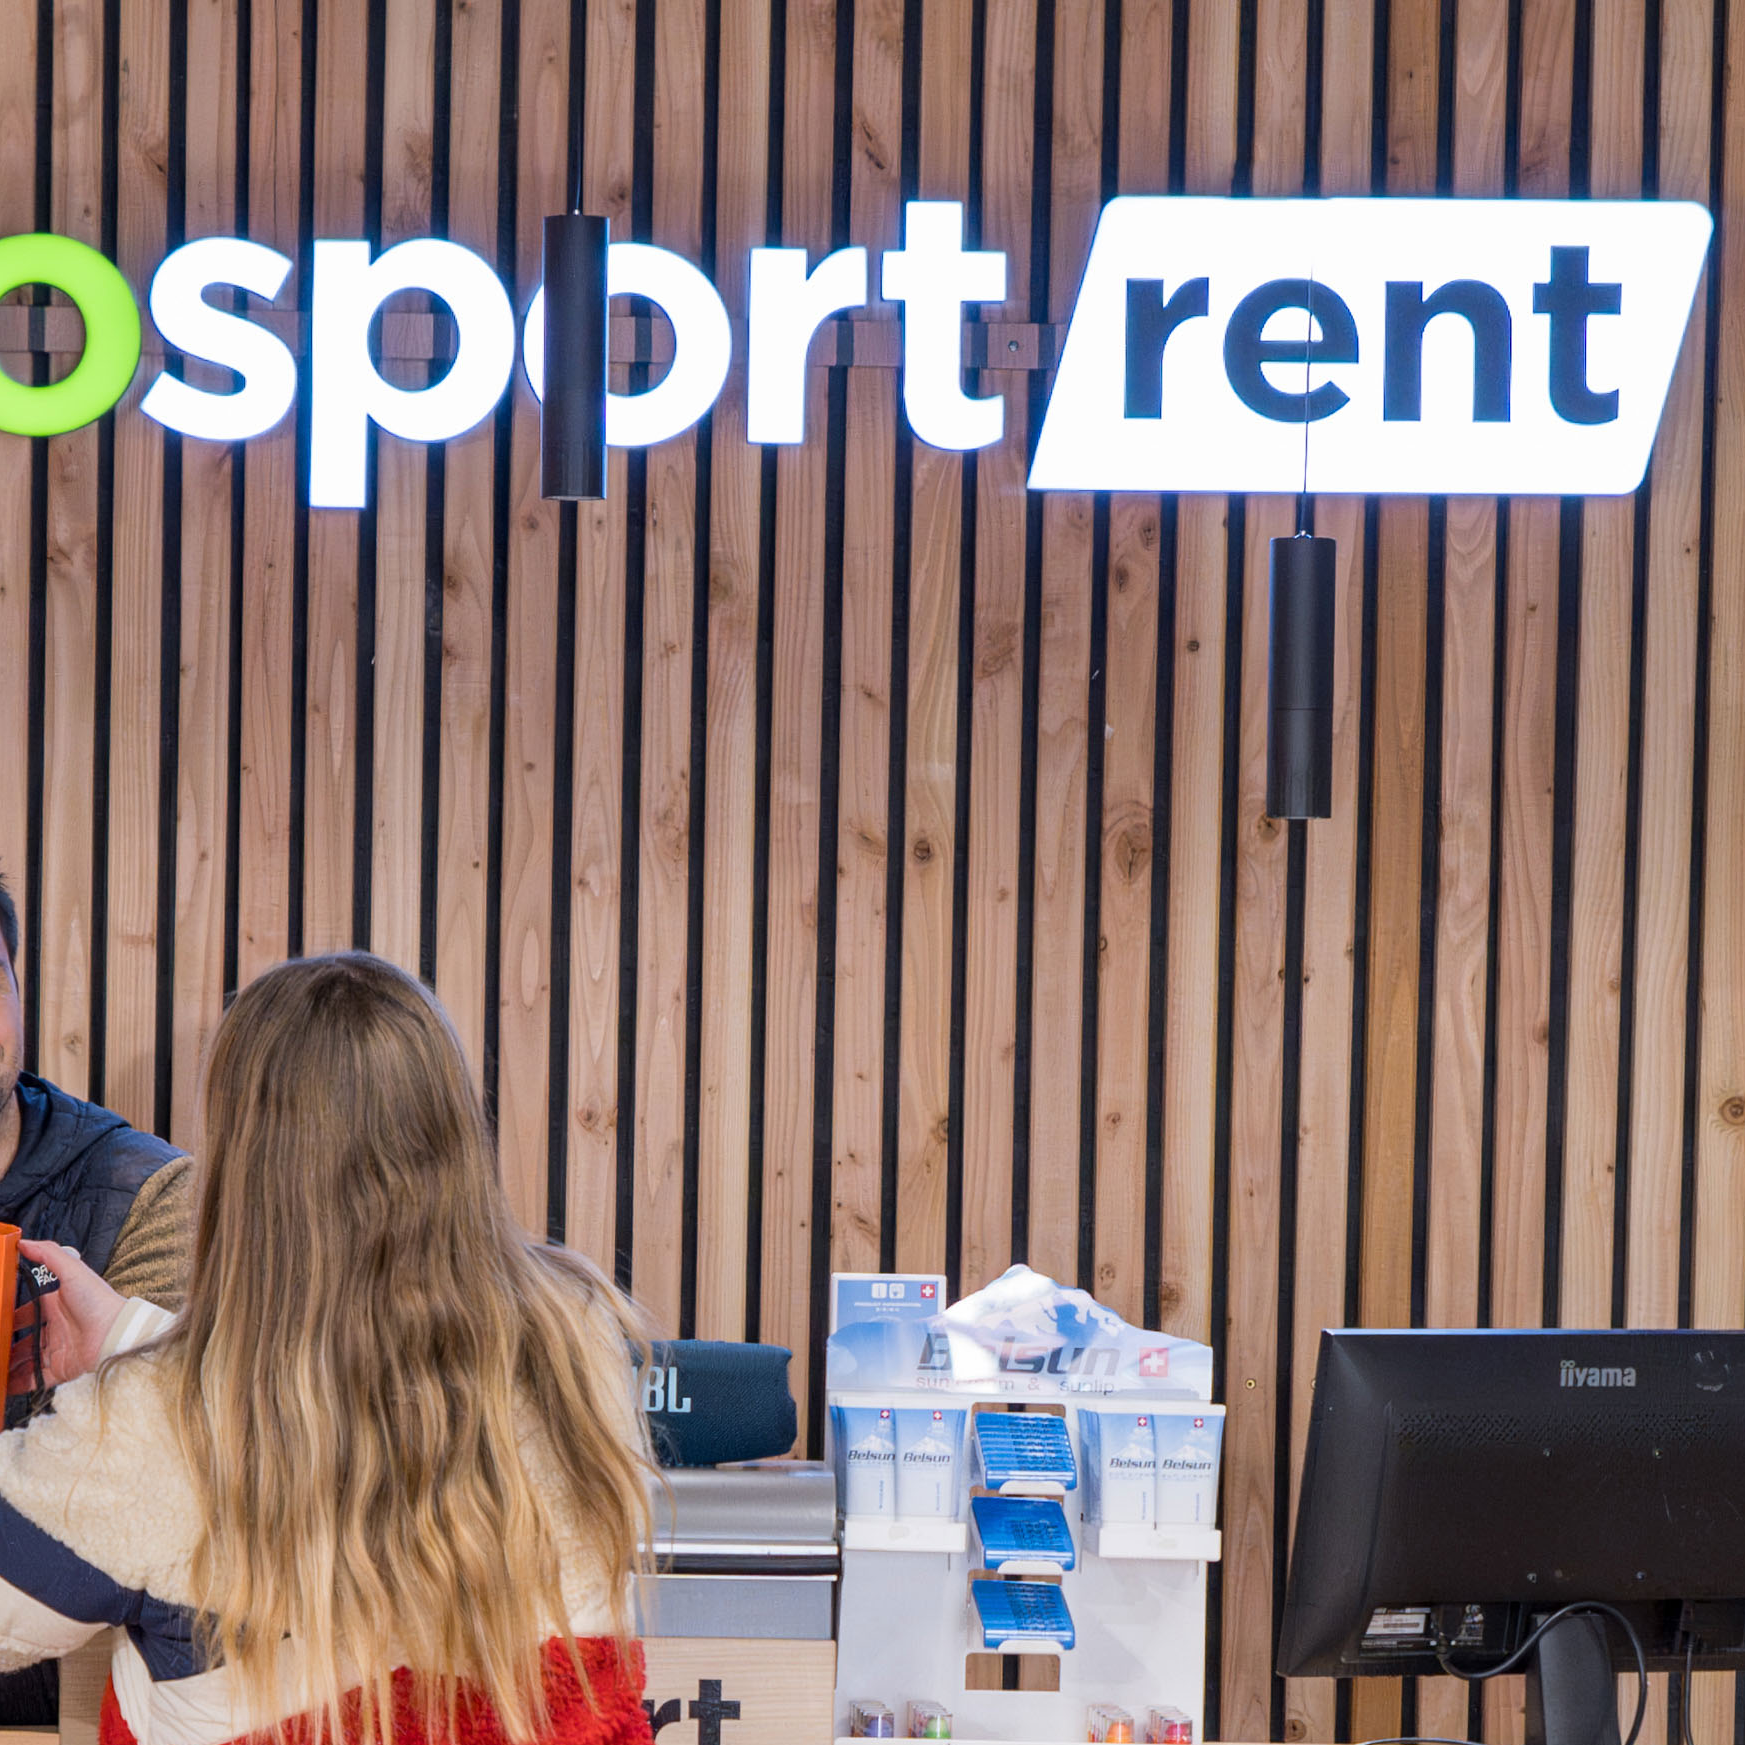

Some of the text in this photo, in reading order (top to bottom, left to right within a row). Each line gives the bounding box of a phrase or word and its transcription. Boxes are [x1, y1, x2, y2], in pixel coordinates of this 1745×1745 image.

[1123, 245, 1622, 425] rent
[35, 1272, 58, 1288] FAC
[917, 1333, 1121, 1376] Blsun
[1559, 1359, 1637, 1388] iiyama
[631, 1366, 692, 1413] BL
[848, 1449, 896, 1461] Belsun
[903, 1452, 951, 1463] Belsun
[1109, 1458, 1156, 1469] Belsun
[1161, 1459, 1212, 1471] Belsun
